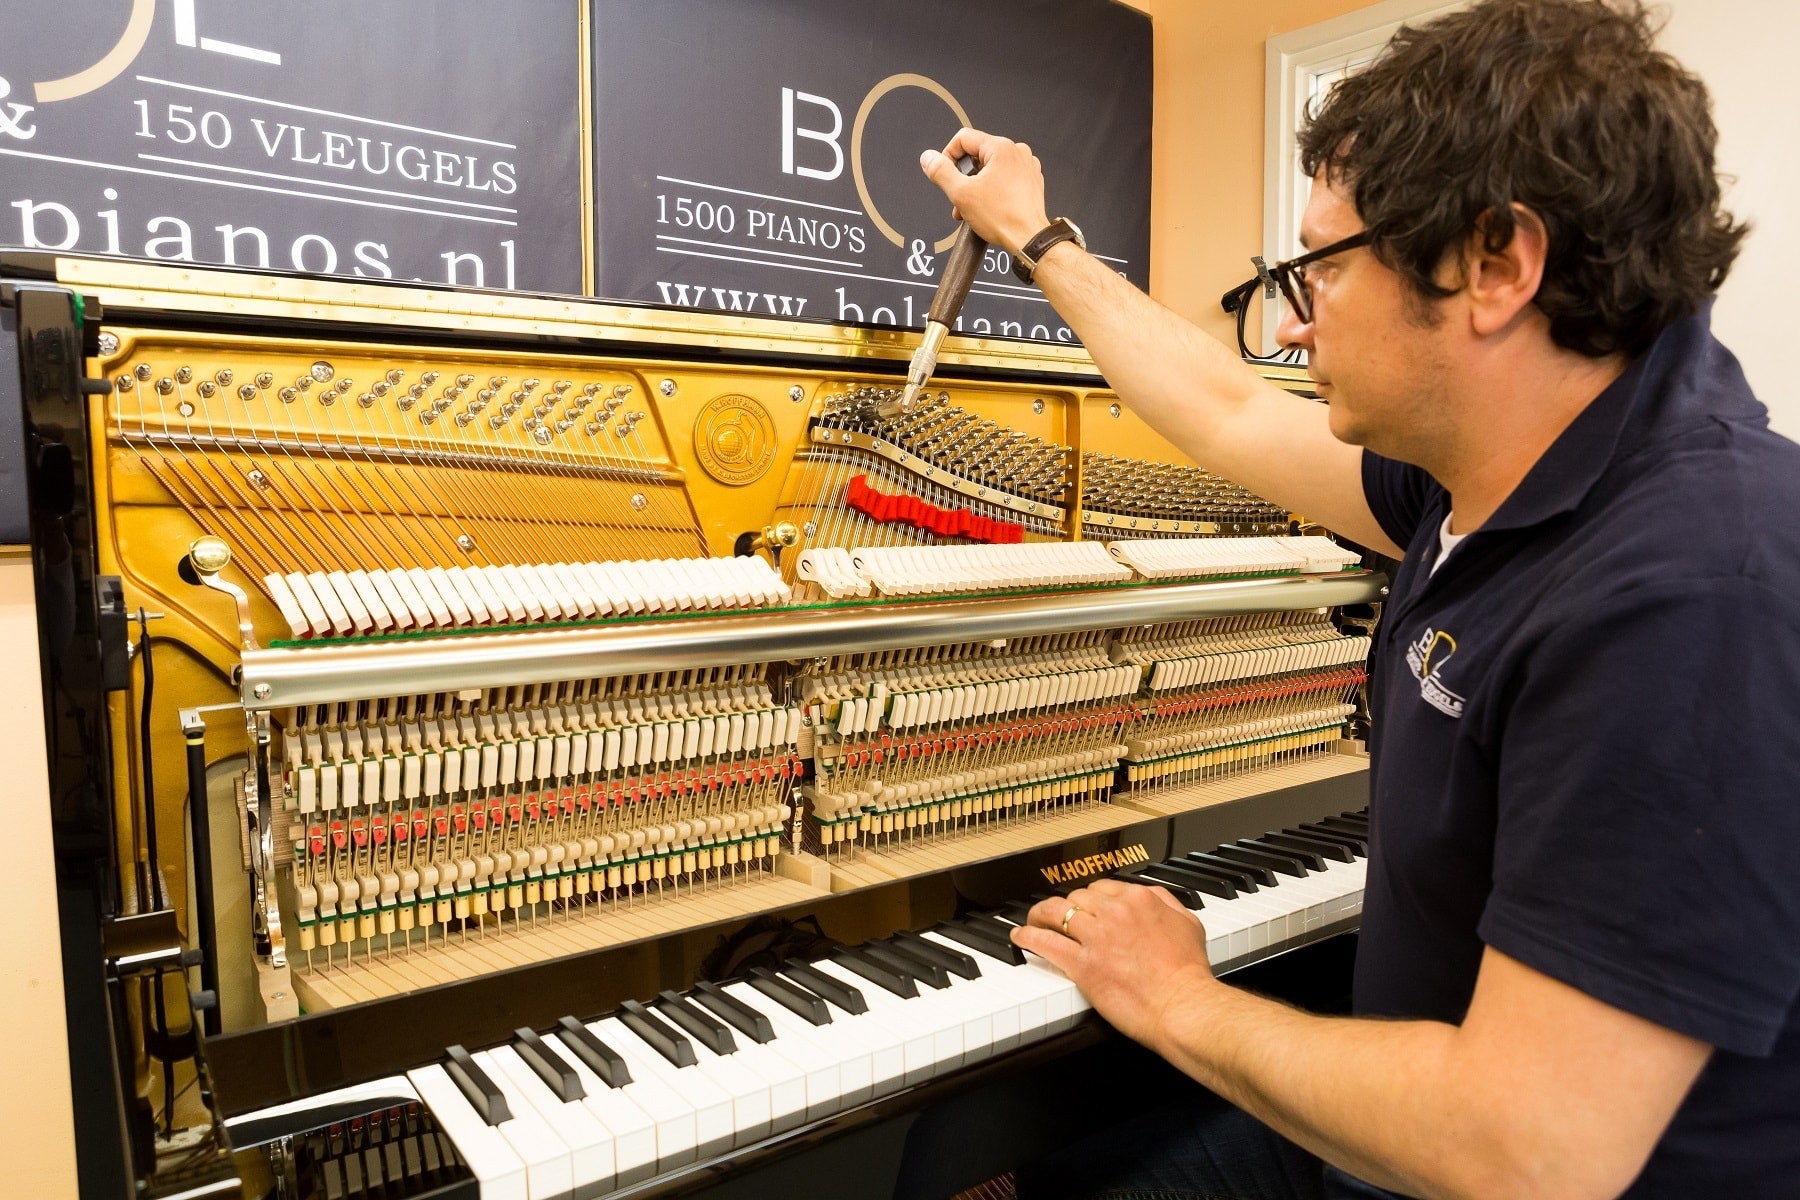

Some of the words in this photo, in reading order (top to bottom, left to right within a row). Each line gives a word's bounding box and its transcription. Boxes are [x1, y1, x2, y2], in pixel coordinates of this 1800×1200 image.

[134, 100, 232, 149] 150
[251, 118, 518, 195] VLEUGELS
[656, 195, 735, 233] 1500
[748, 210, 866, 253] PIANO'S
[906, 239, 935, 277] &
[1040, 843, 1150, 885] W.HOFFMANN
